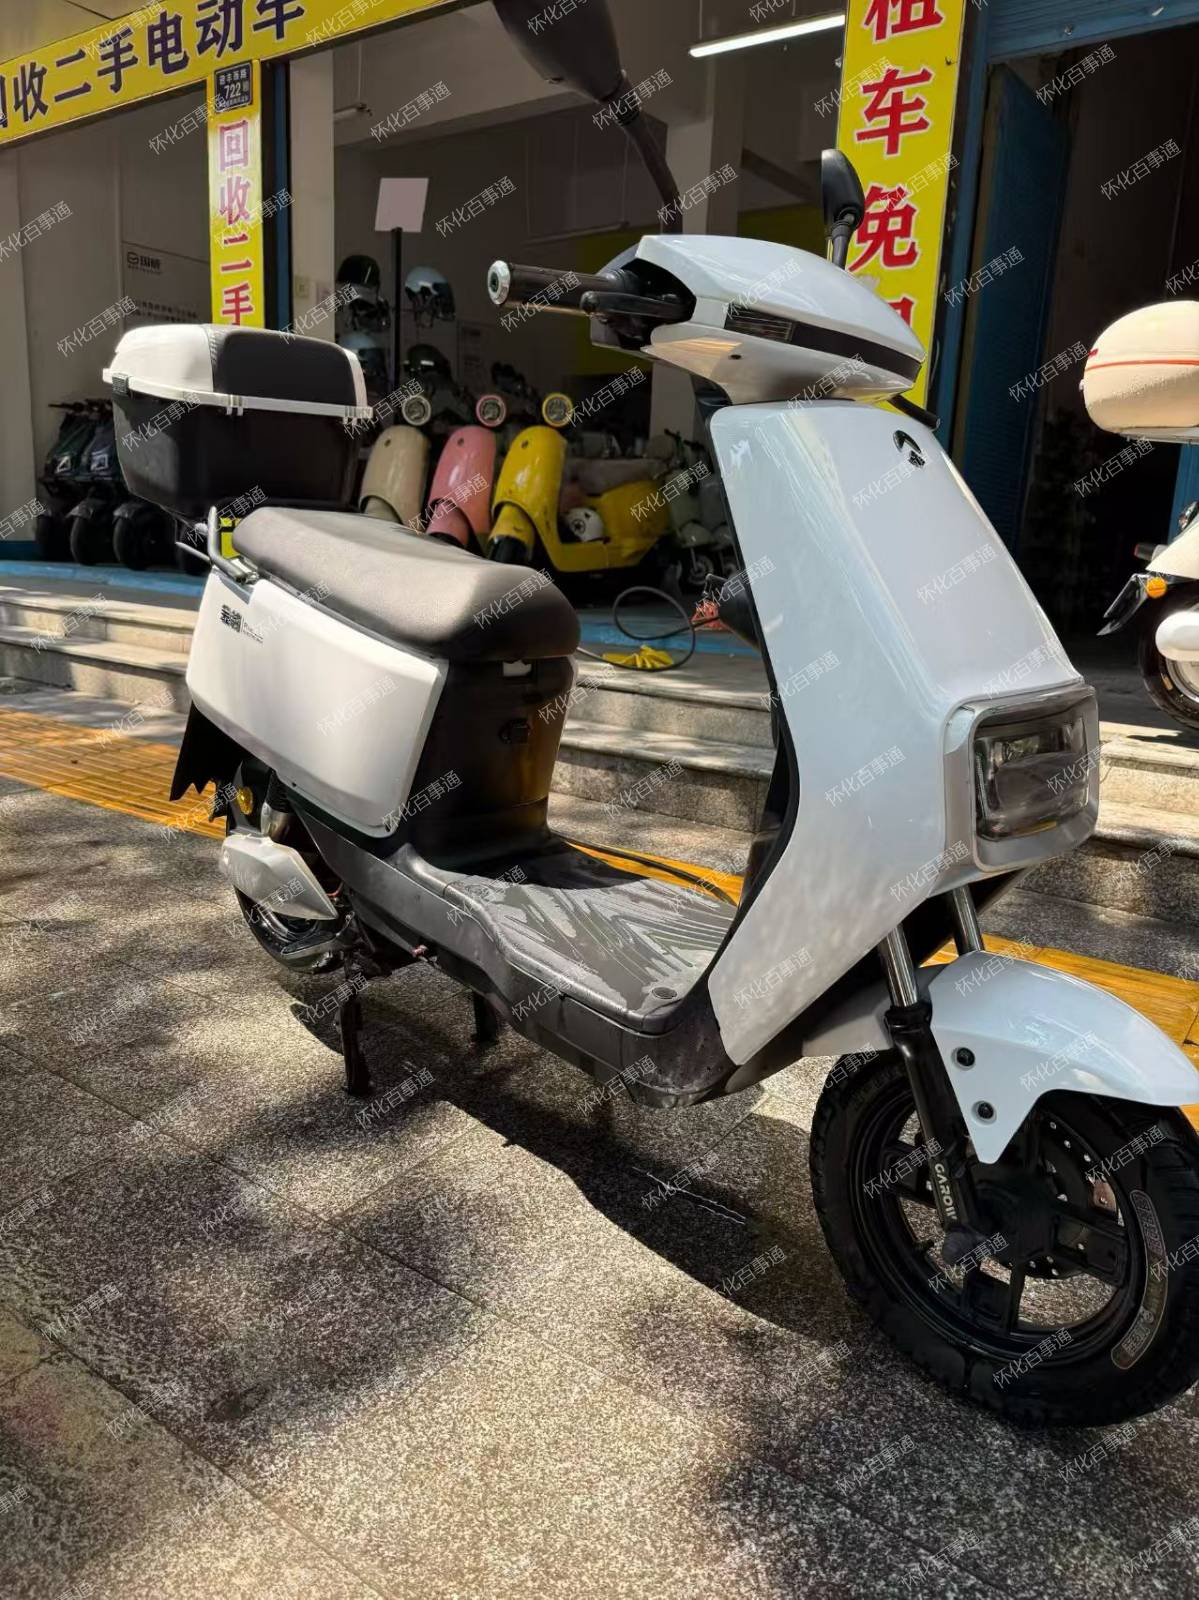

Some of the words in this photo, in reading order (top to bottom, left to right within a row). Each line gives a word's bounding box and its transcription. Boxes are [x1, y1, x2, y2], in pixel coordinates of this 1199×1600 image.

[0, 0, 305, 128] 收二手电动车
[224, 82, 242, 100] 722
[219, 119, 253, 327] 回收二手
[848, 0, 943, 328] 租车免
